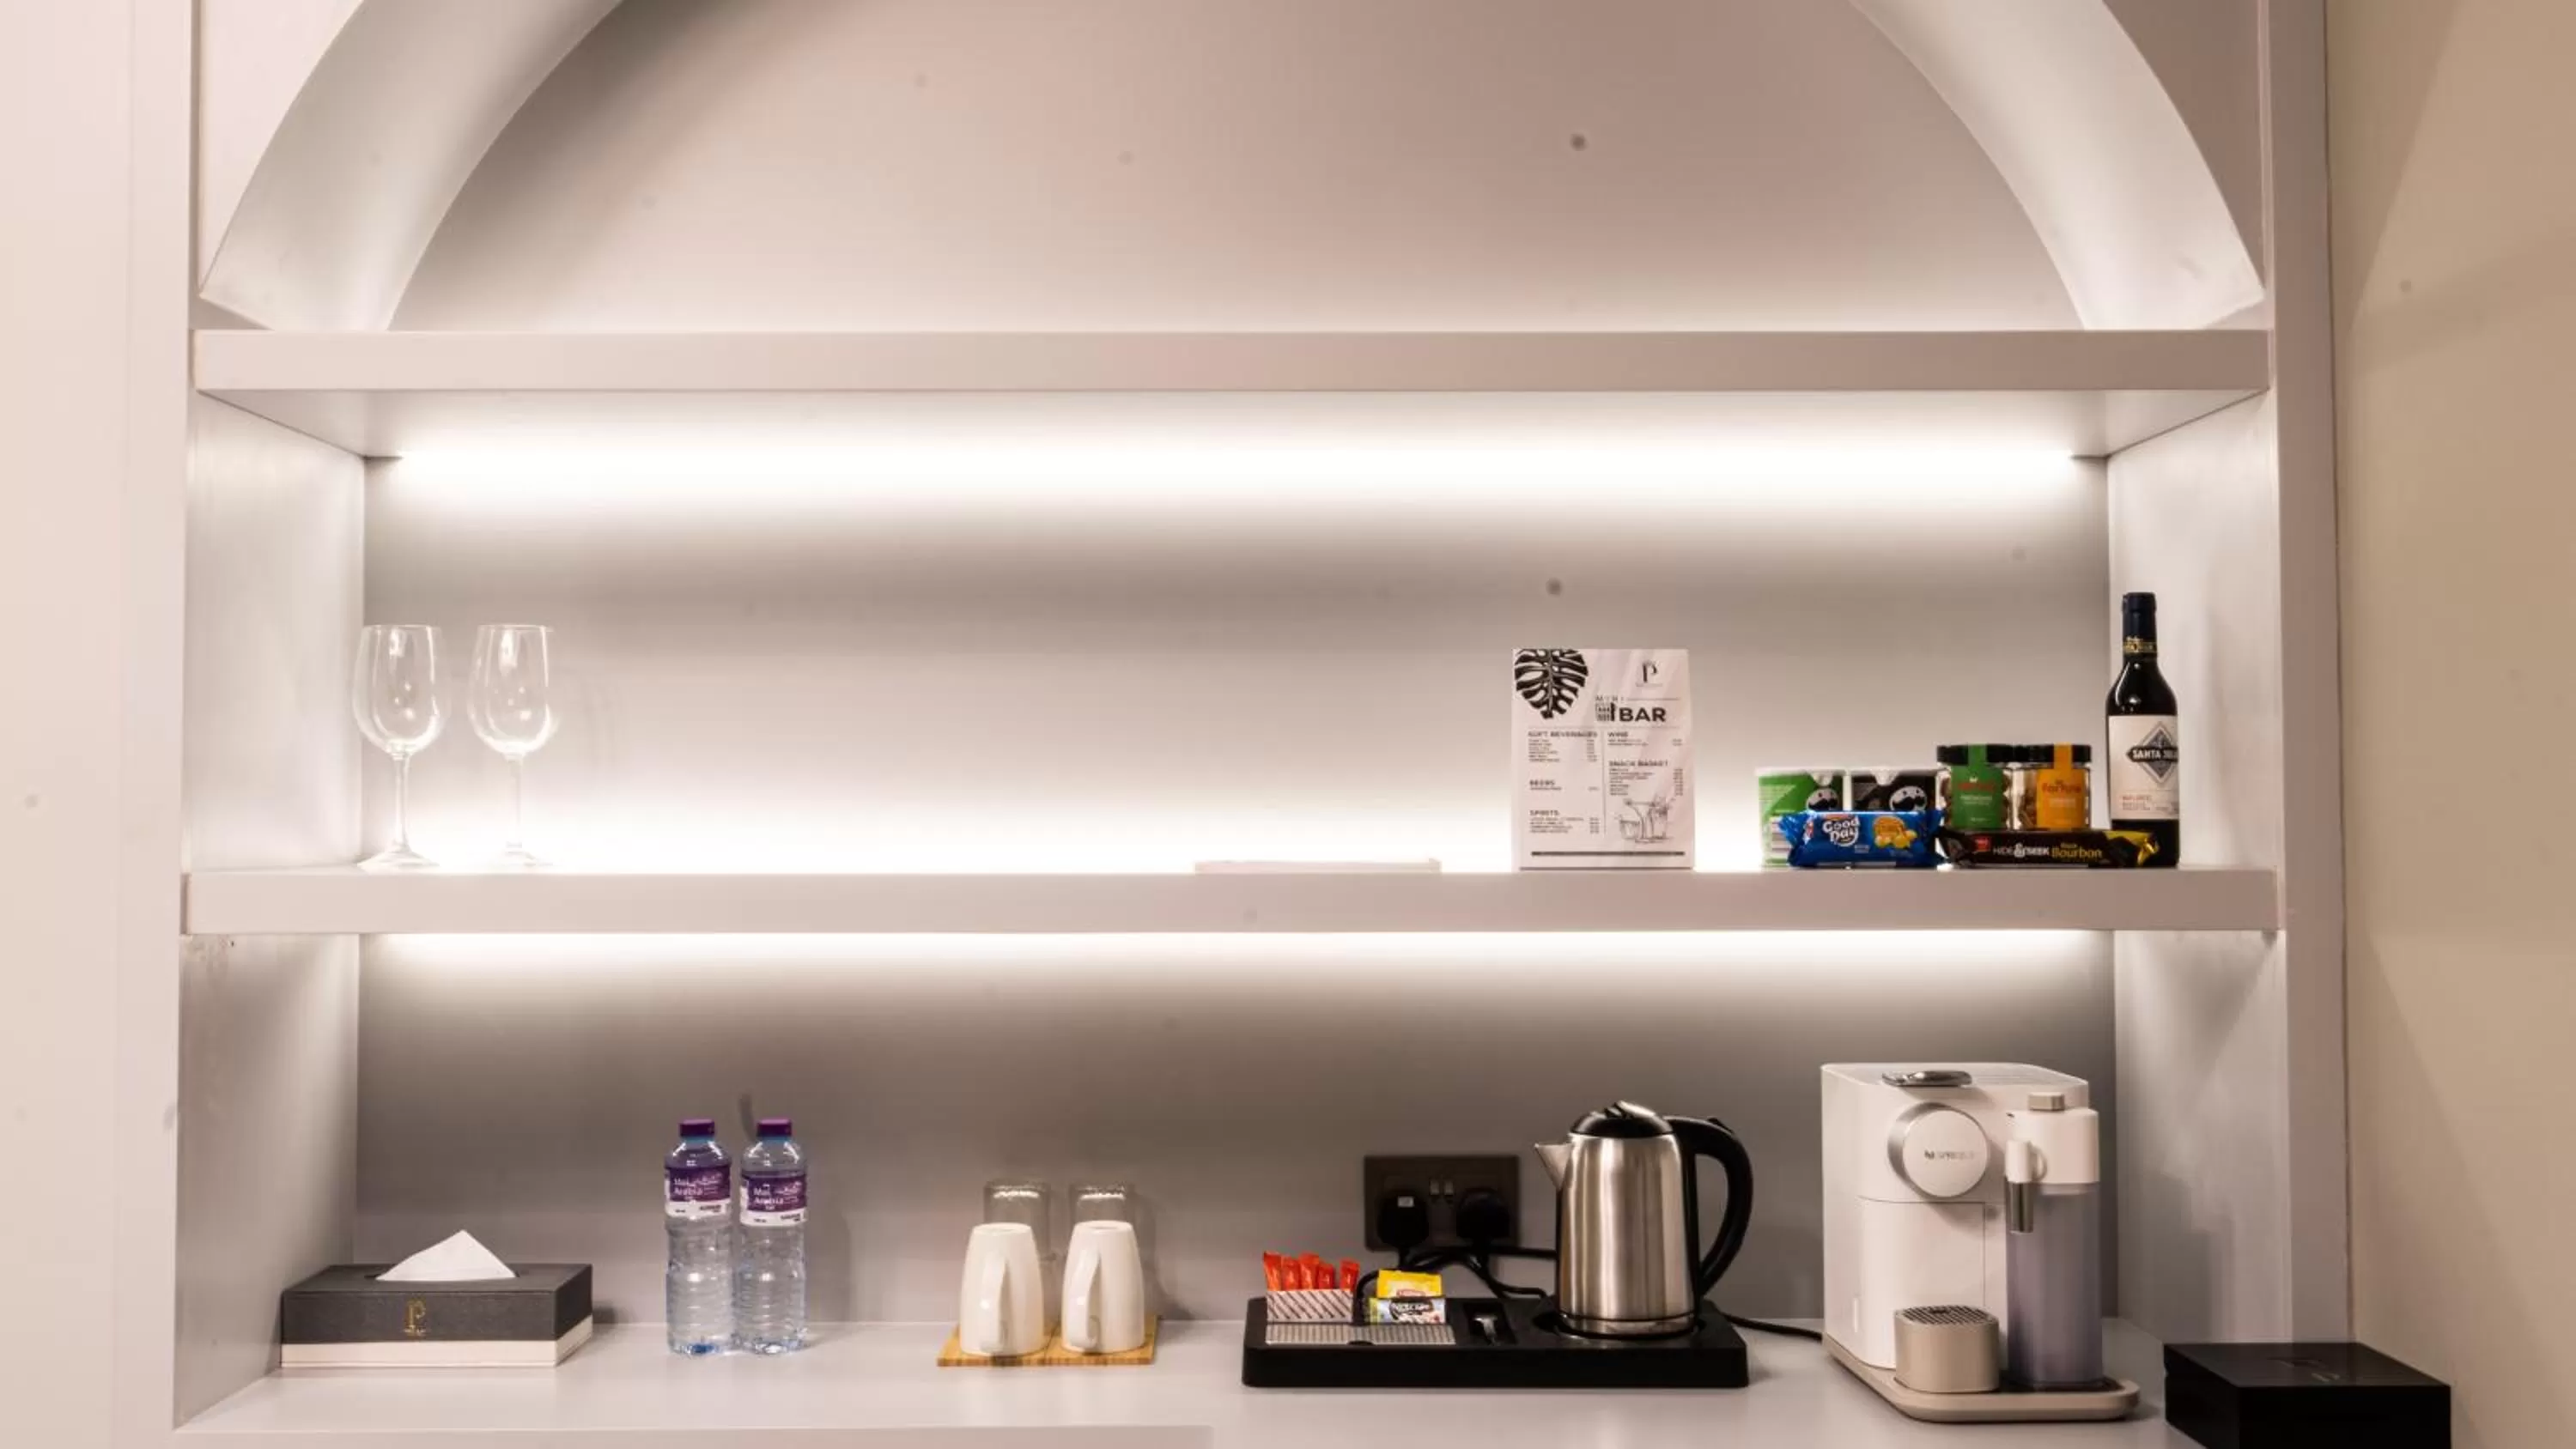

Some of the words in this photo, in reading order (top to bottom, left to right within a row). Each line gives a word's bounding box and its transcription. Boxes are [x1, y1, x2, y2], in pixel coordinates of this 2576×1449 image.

[1619, 706, 1667, 722] BAR
[2131, 749, 2161, 760] SANTA
[1821, 815, 1861, 832] Good
[1829, 828, 1859, 847] Day
[2050, 847, 2103, 859] Bourbon
